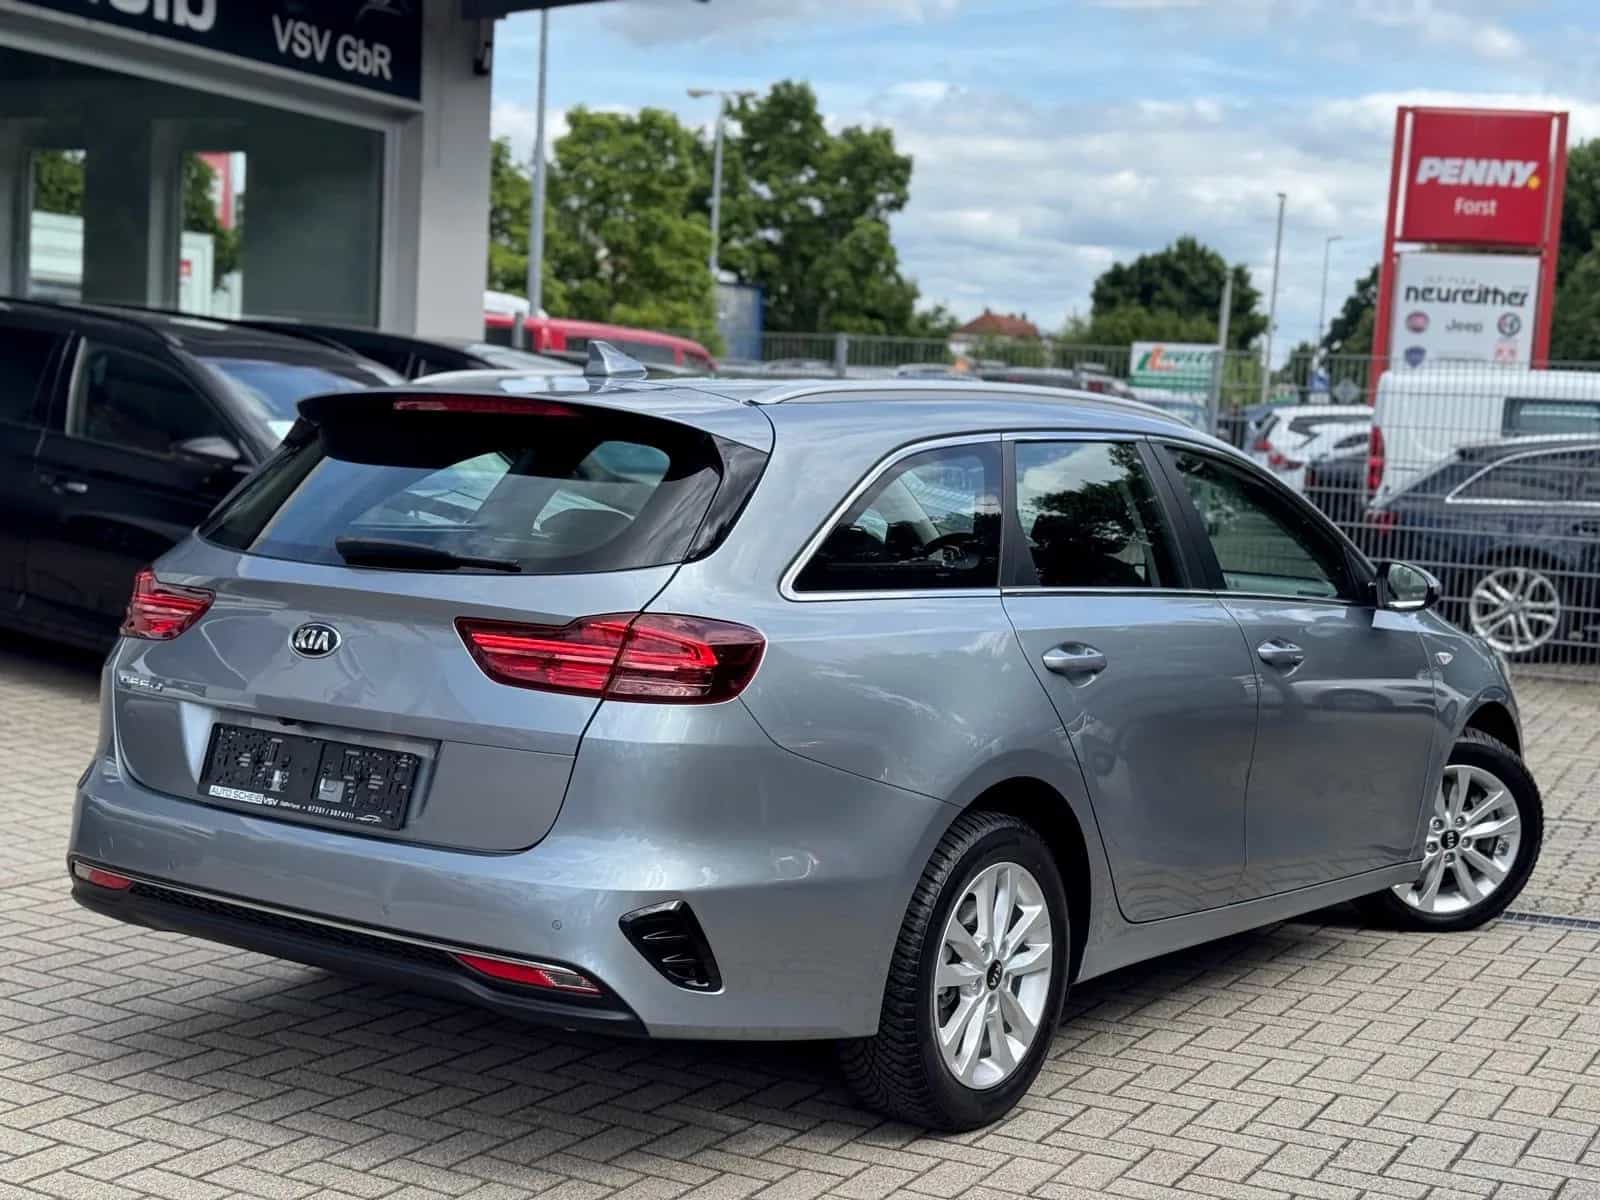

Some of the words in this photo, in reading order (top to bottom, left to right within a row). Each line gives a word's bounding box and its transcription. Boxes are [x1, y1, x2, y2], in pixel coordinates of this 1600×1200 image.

[272, 14, 331, 63] VSV
[336, 34, 392, 81] GbR
[1453, 196, 1498, 217] Forst
[1404, 283, 1530, 307] neureither
[1445, 316, 1484, 334] Jeep
[295, 628, 329, 651] KIA
[210, 785, 233, 798] AUTO
